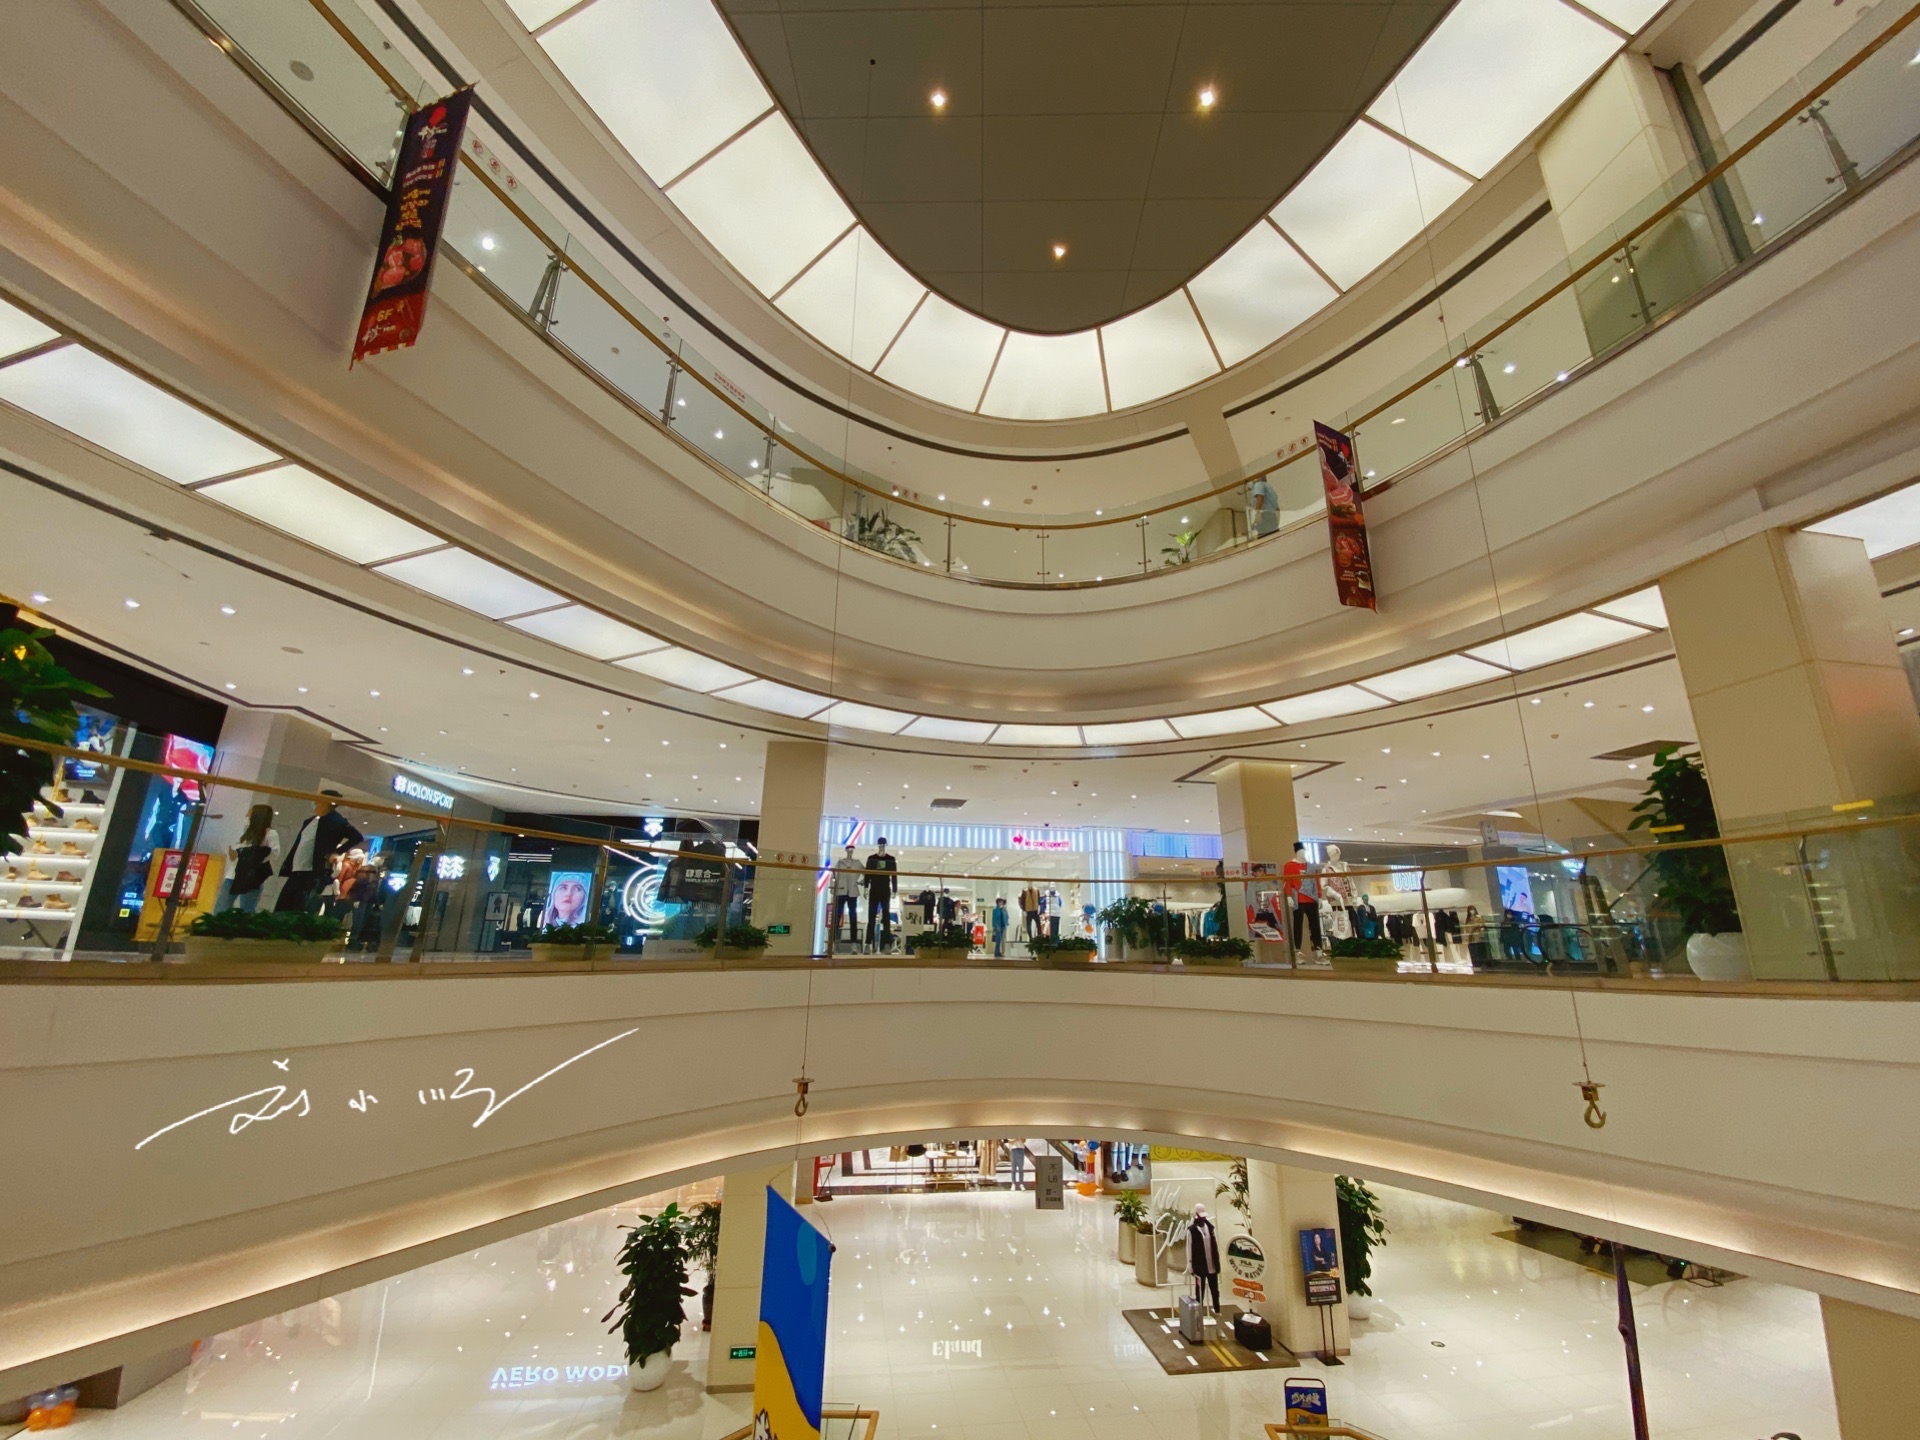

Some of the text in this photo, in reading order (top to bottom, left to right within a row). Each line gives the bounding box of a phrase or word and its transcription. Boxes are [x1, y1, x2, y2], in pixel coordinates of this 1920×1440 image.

[376, 308, 394, 322] 6F
[405, 781, 455, 810] KOLON SPORT
